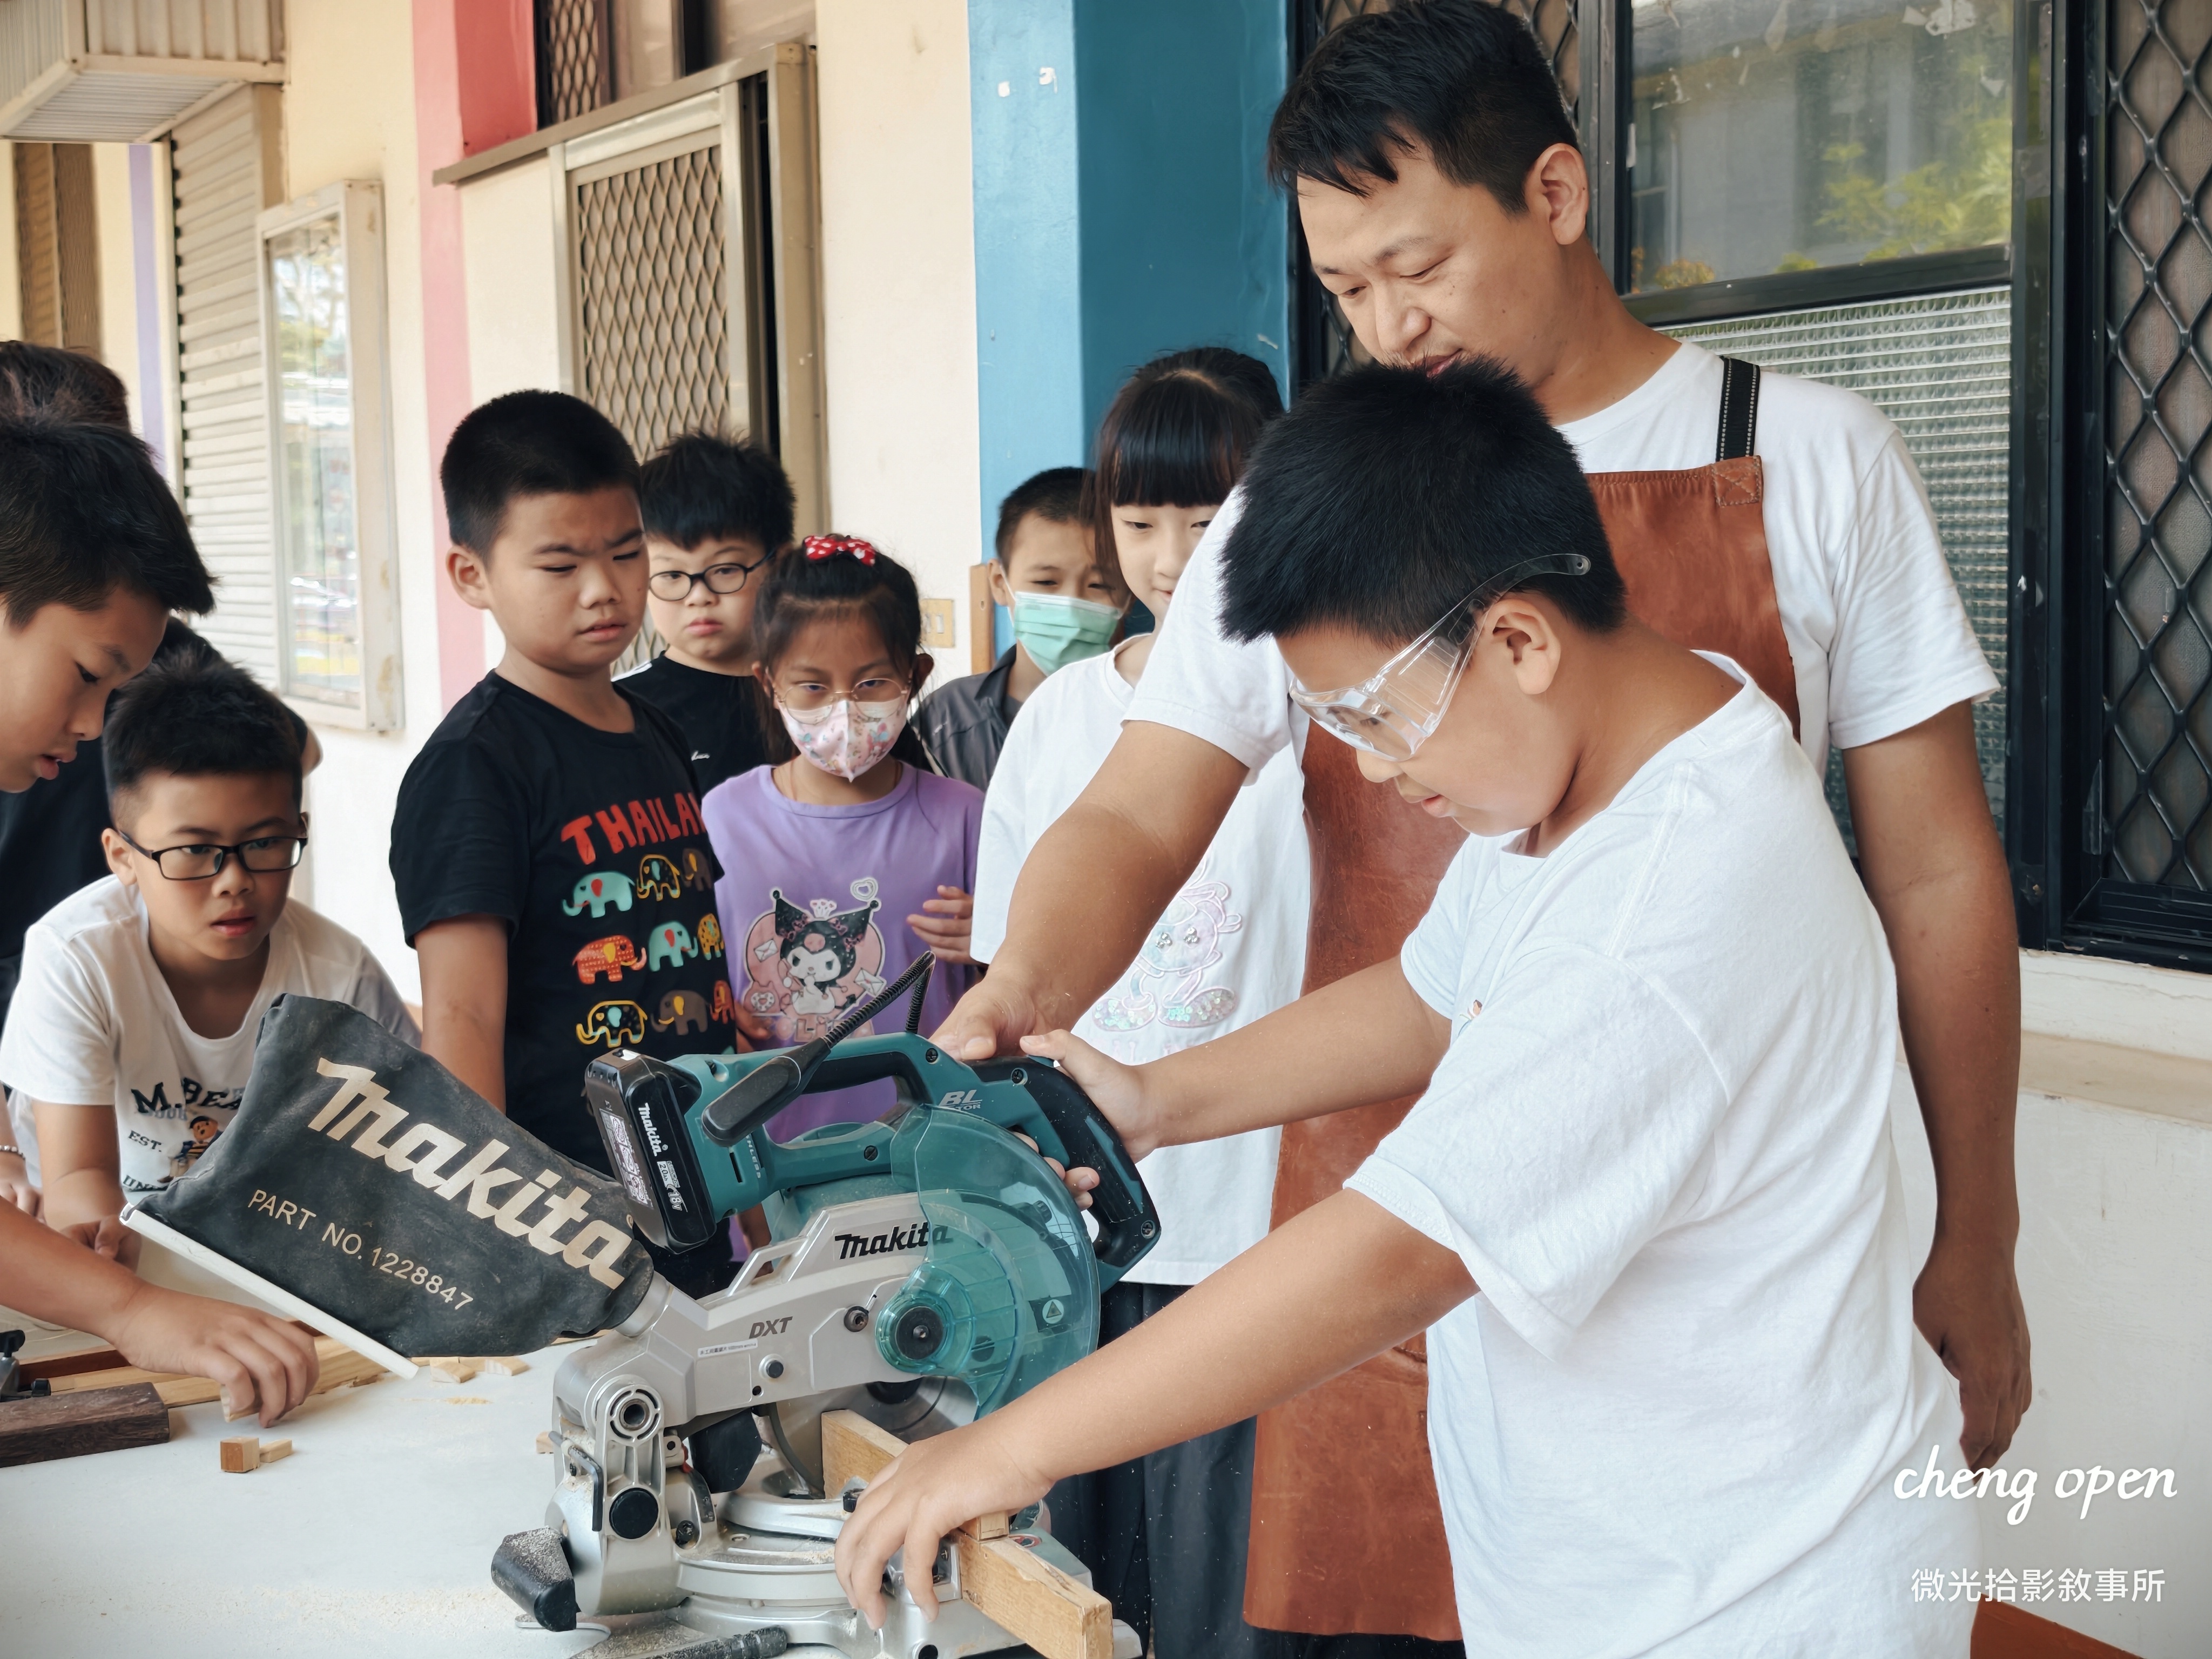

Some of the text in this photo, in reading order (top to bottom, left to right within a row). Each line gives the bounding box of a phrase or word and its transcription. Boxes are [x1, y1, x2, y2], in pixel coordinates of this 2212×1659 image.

[938, 1089, 983, 1107] BL
[127, 1130, 162, 1152] EST.
[248, 1189, 316, 1230] PART
[748, 1316, 793, 1339] DXT
